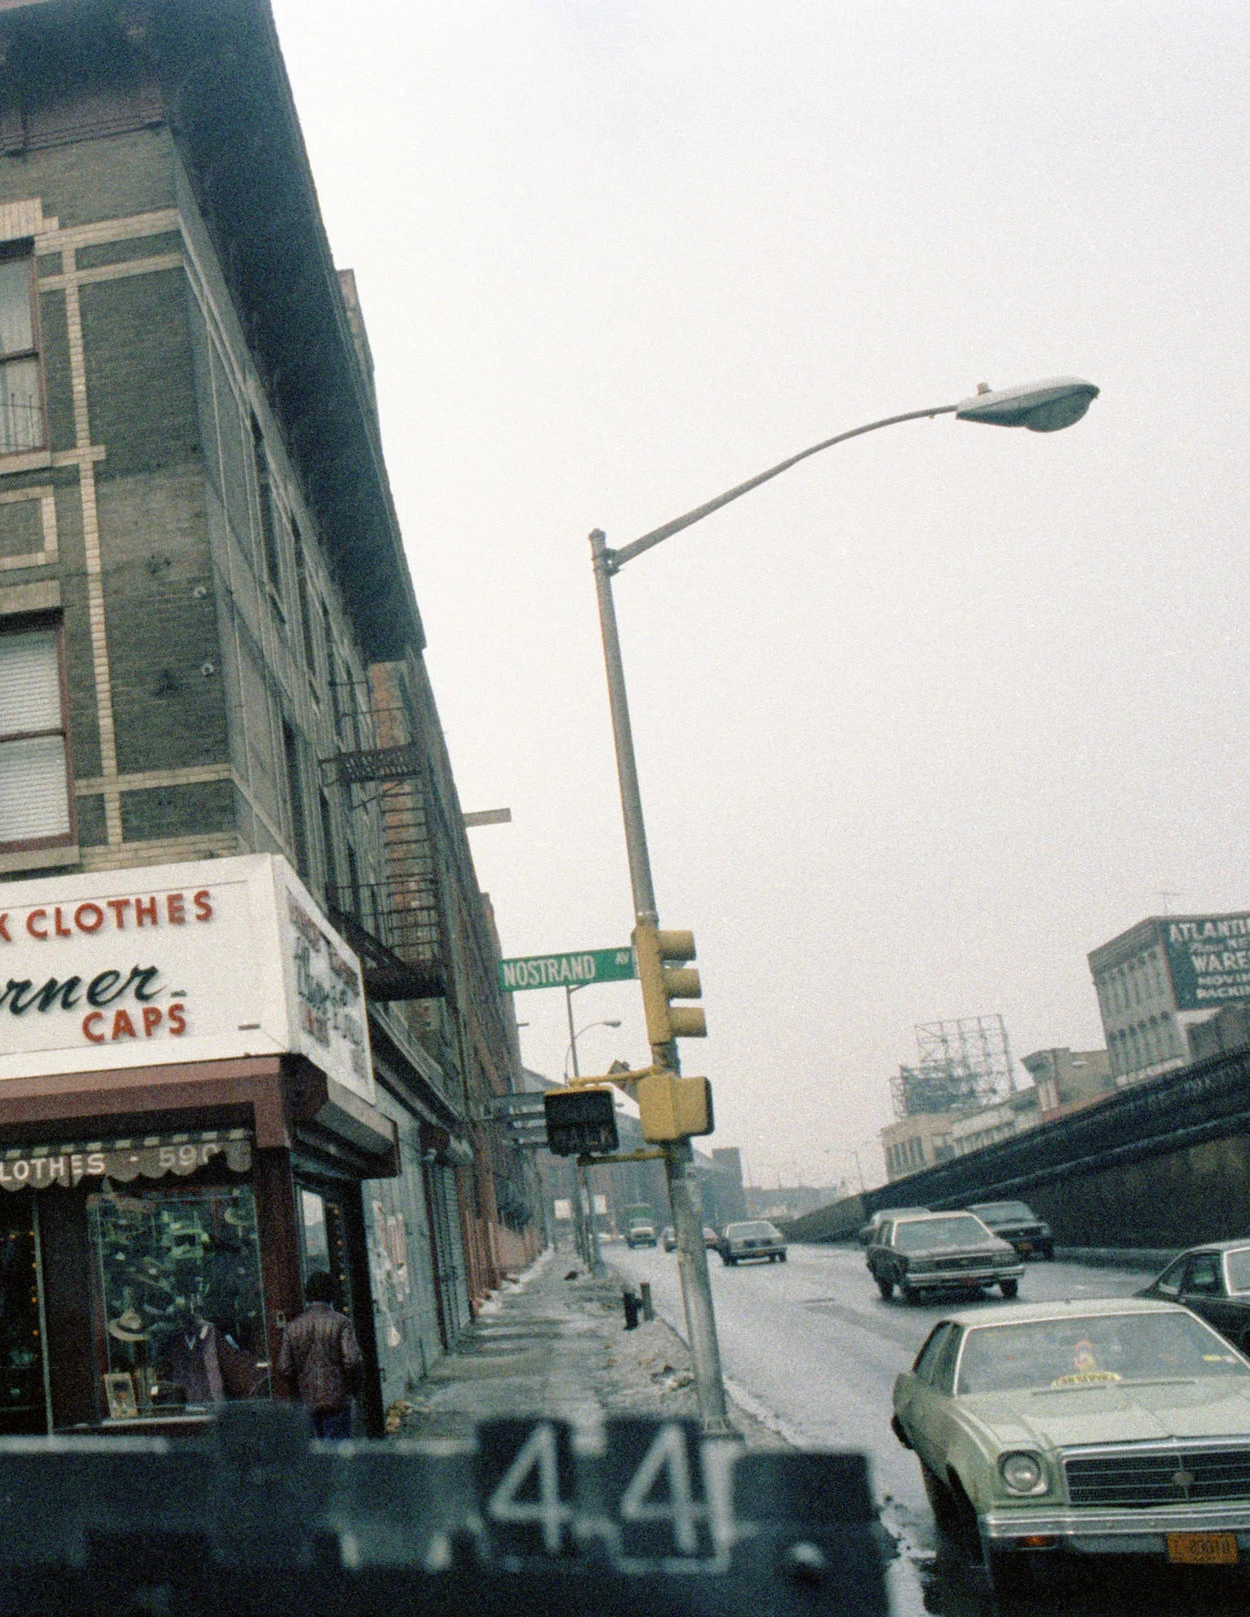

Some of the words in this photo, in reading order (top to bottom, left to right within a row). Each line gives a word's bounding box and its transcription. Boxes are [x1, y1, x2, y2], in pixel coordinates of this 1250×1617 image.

[26, 890, 213, 940] CLOTHES
[503, 955, 596, 987] NOSTRAND
[615, 951, 630, 966] AV
[82, 1003, 187, 1043] CAPS
[488, 1420, 712, 1552] 44
